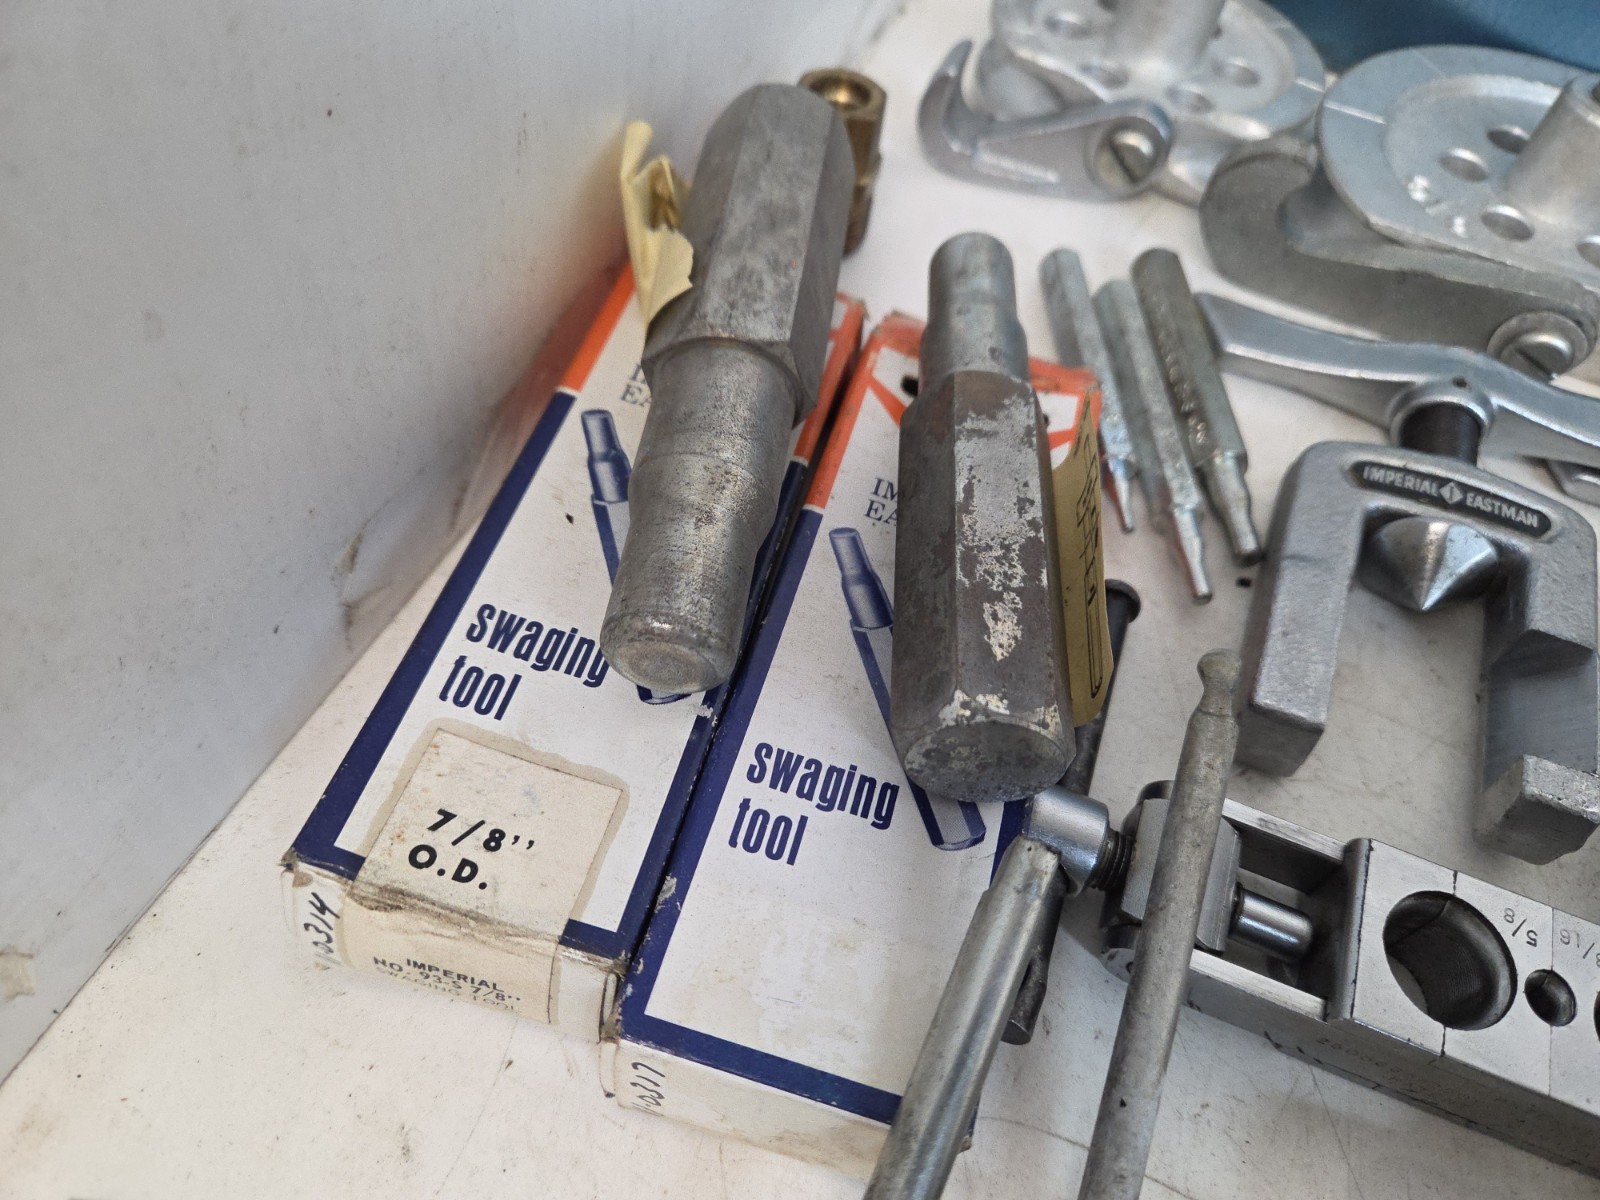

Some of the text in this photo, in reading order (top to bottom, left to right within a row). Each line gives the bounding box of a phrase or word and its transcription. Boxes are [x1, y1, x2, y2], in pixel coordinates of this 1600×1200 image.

[1362, 465, 1539, 528] IMPERIAL EASTMAN
[438, 655, 522, 721] tool
[746, 742, 900, 830] swaging
[728, 797, 808, 866] tool
[1503, 907, 1539, 947] 5/8
[406, 957, 505, 993] IMPERIAL
